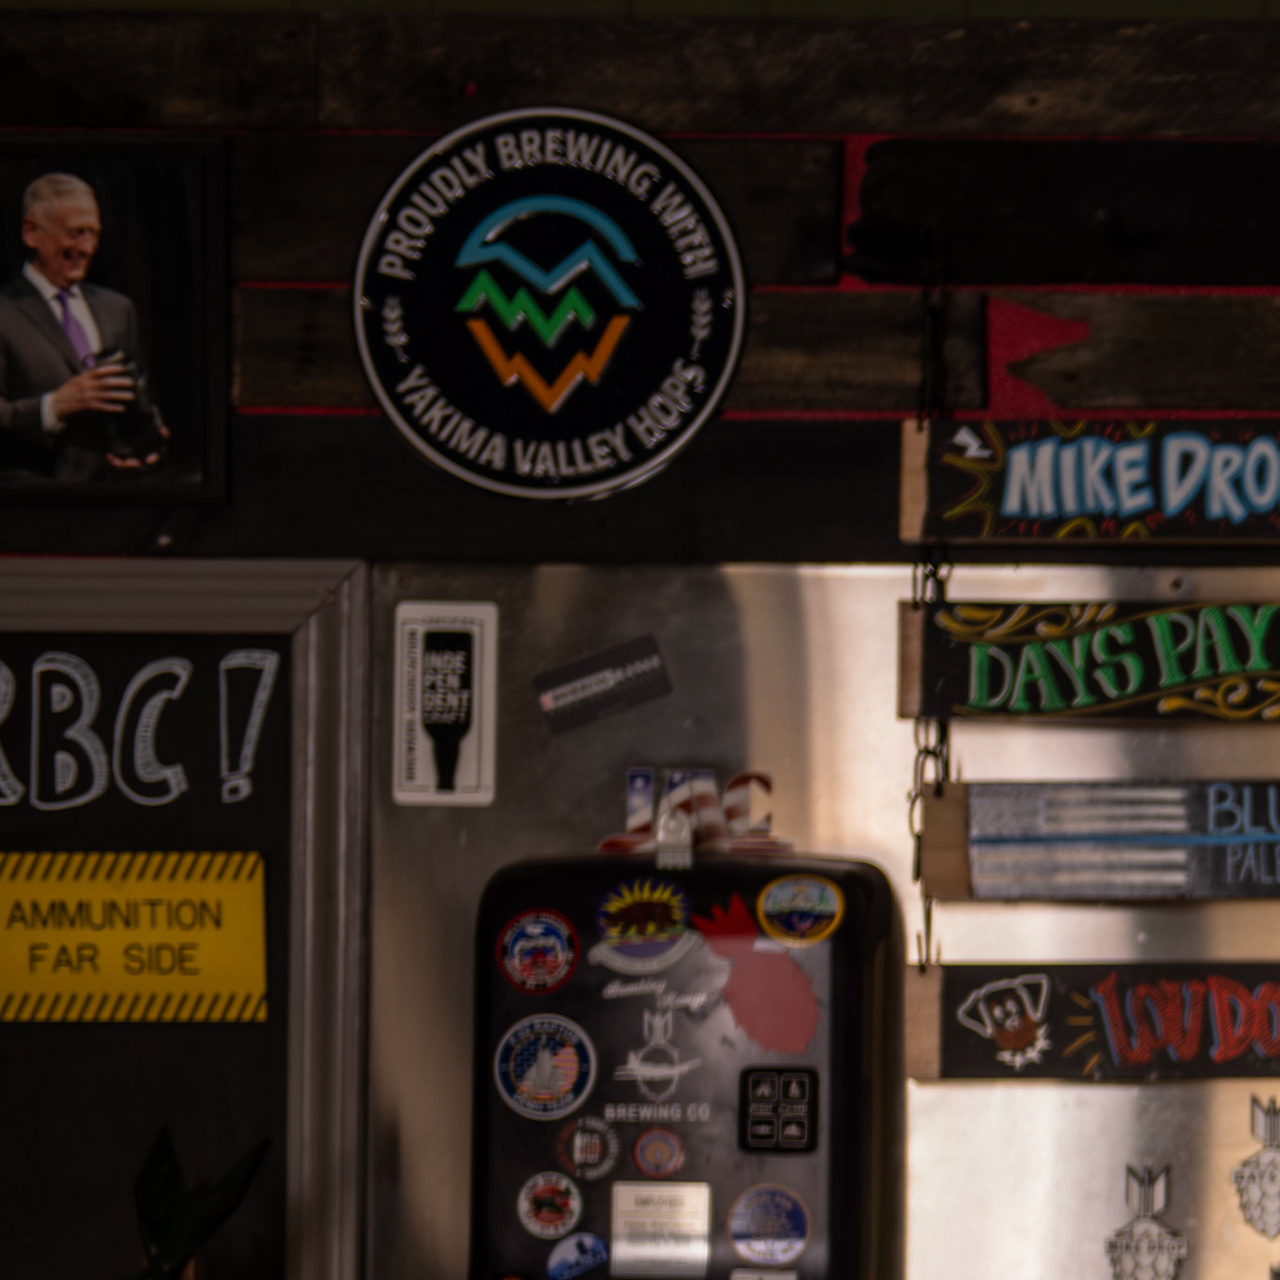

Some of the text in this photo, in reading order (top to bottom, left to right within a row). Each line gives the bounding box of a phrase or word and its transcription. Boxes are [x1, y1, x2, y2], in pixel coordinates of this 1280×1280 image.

[376, 127, 721, 282] PROUDLY BREWING WITH
[394, 356, 709, 478] YAKIMA VALLEY HOPS
[1000, 436, 1154, 520] MIKE
[966, 620, 1144, 714] DAYS
[6, 899, 223, 930] AMMUNITION
[29, 944, 200, 974] FAR SIDE
[604, 1104, 710, 1120] BREWING CO
